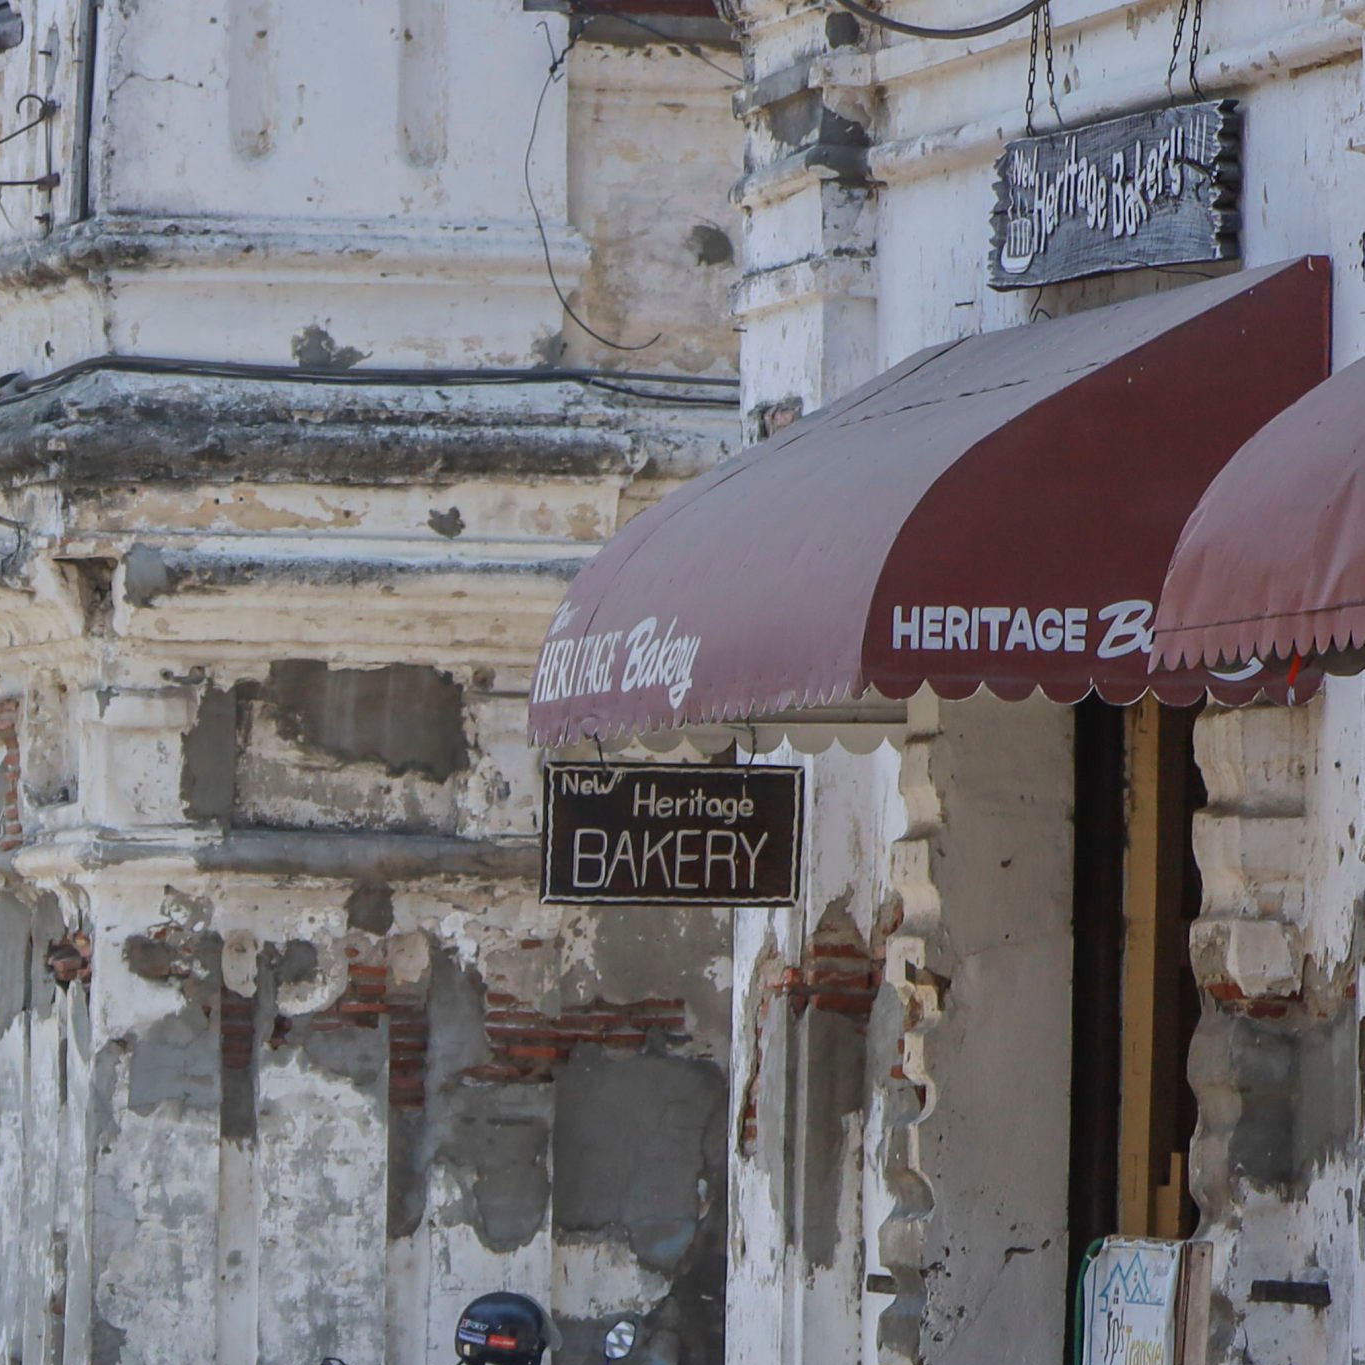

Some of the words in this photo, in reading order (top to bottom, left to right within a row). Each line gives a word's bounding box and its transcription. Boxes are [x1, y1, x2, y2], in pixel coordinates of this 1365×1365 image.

[1013, 145, 1039, 189] New
[1033, 135, 1107, 254] Heritage
[1112, 126, 1184, 238] Bakery
[892, 605, 1088, 652] HERITAGE
[533, 631, 624, 704] HERITAGE
[621, 616, 701, 710] Bakery
[633, 783, 755, 825] Heritage
[573, 828, 768, 889] BAKERY
